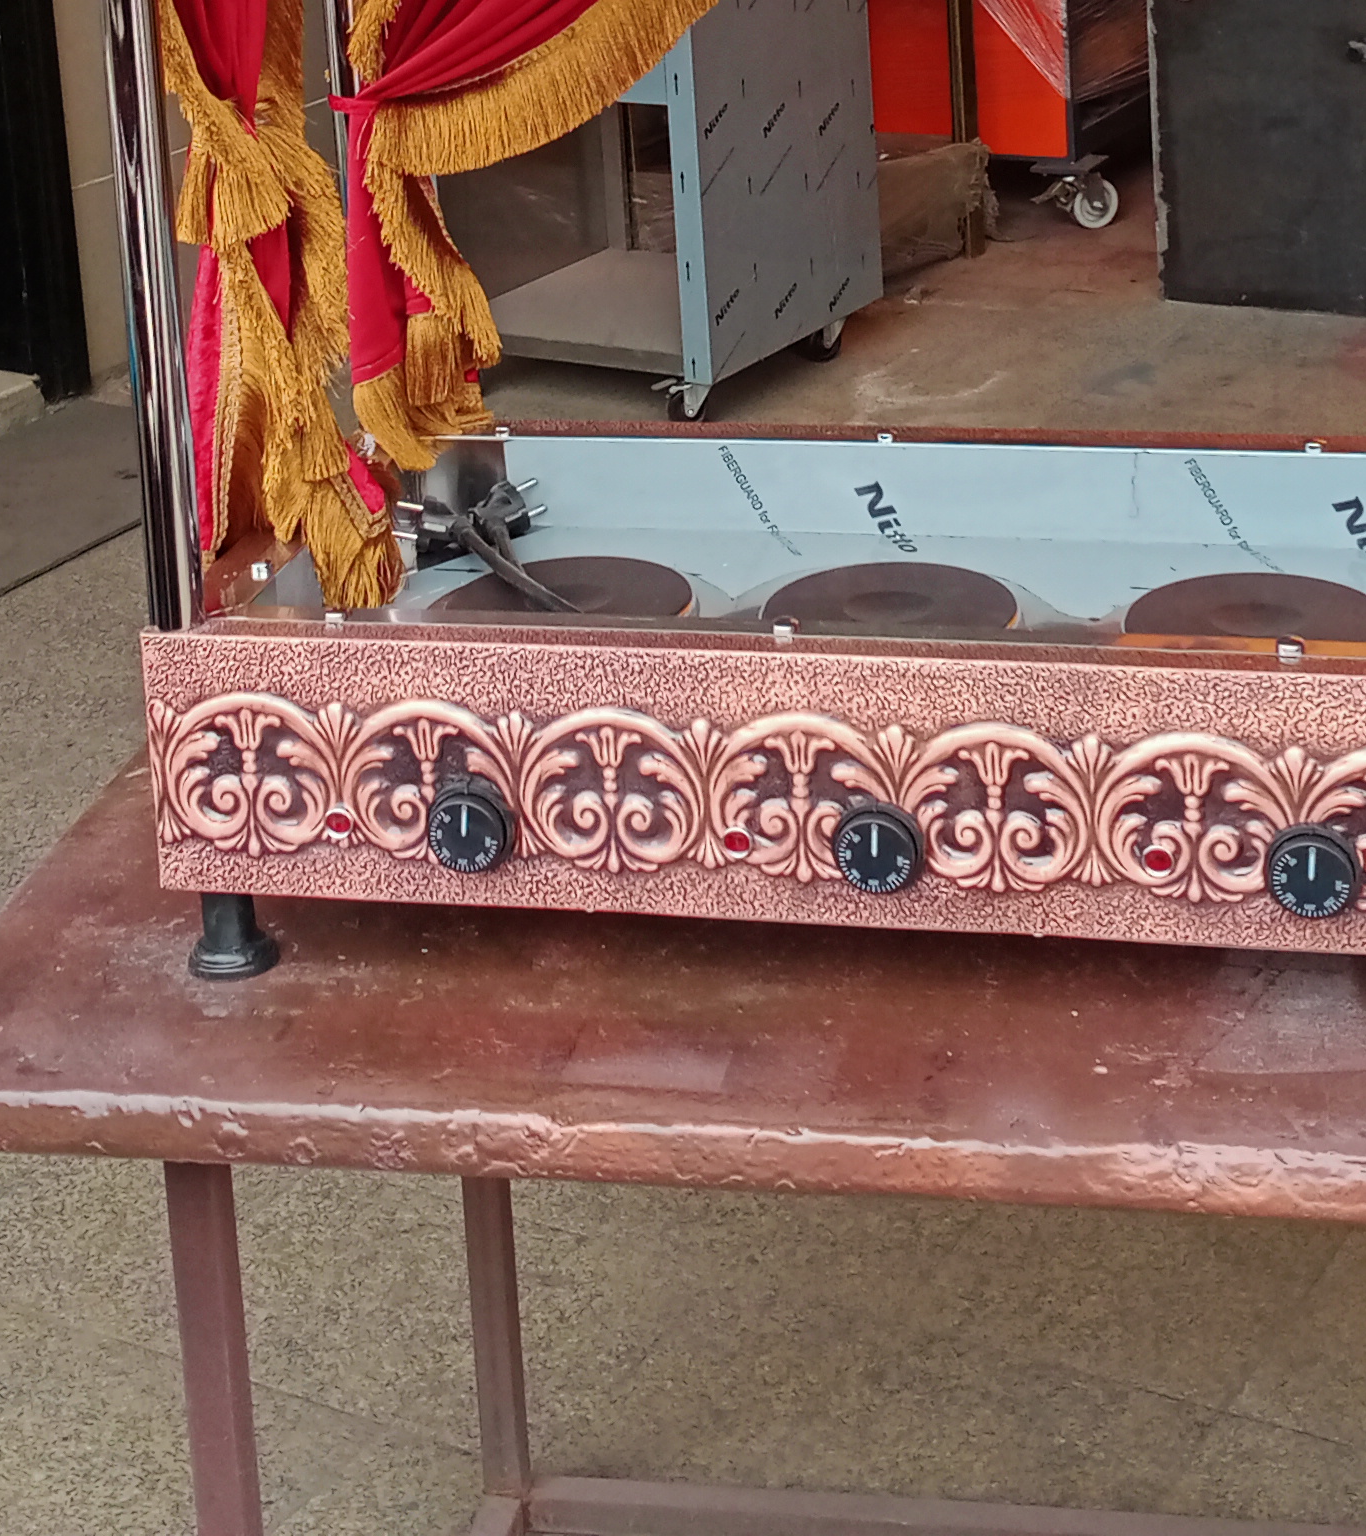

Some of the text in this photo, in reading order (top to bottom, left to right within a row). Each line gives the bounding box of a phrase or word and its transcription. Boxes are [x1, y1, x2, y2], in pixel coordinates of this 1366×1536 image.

[718, 445, 763, 511] FIBERGUARD
[1185, 457, 1233, 527] FIBERGUARD
[853, 480, 918, 554] Nitto
